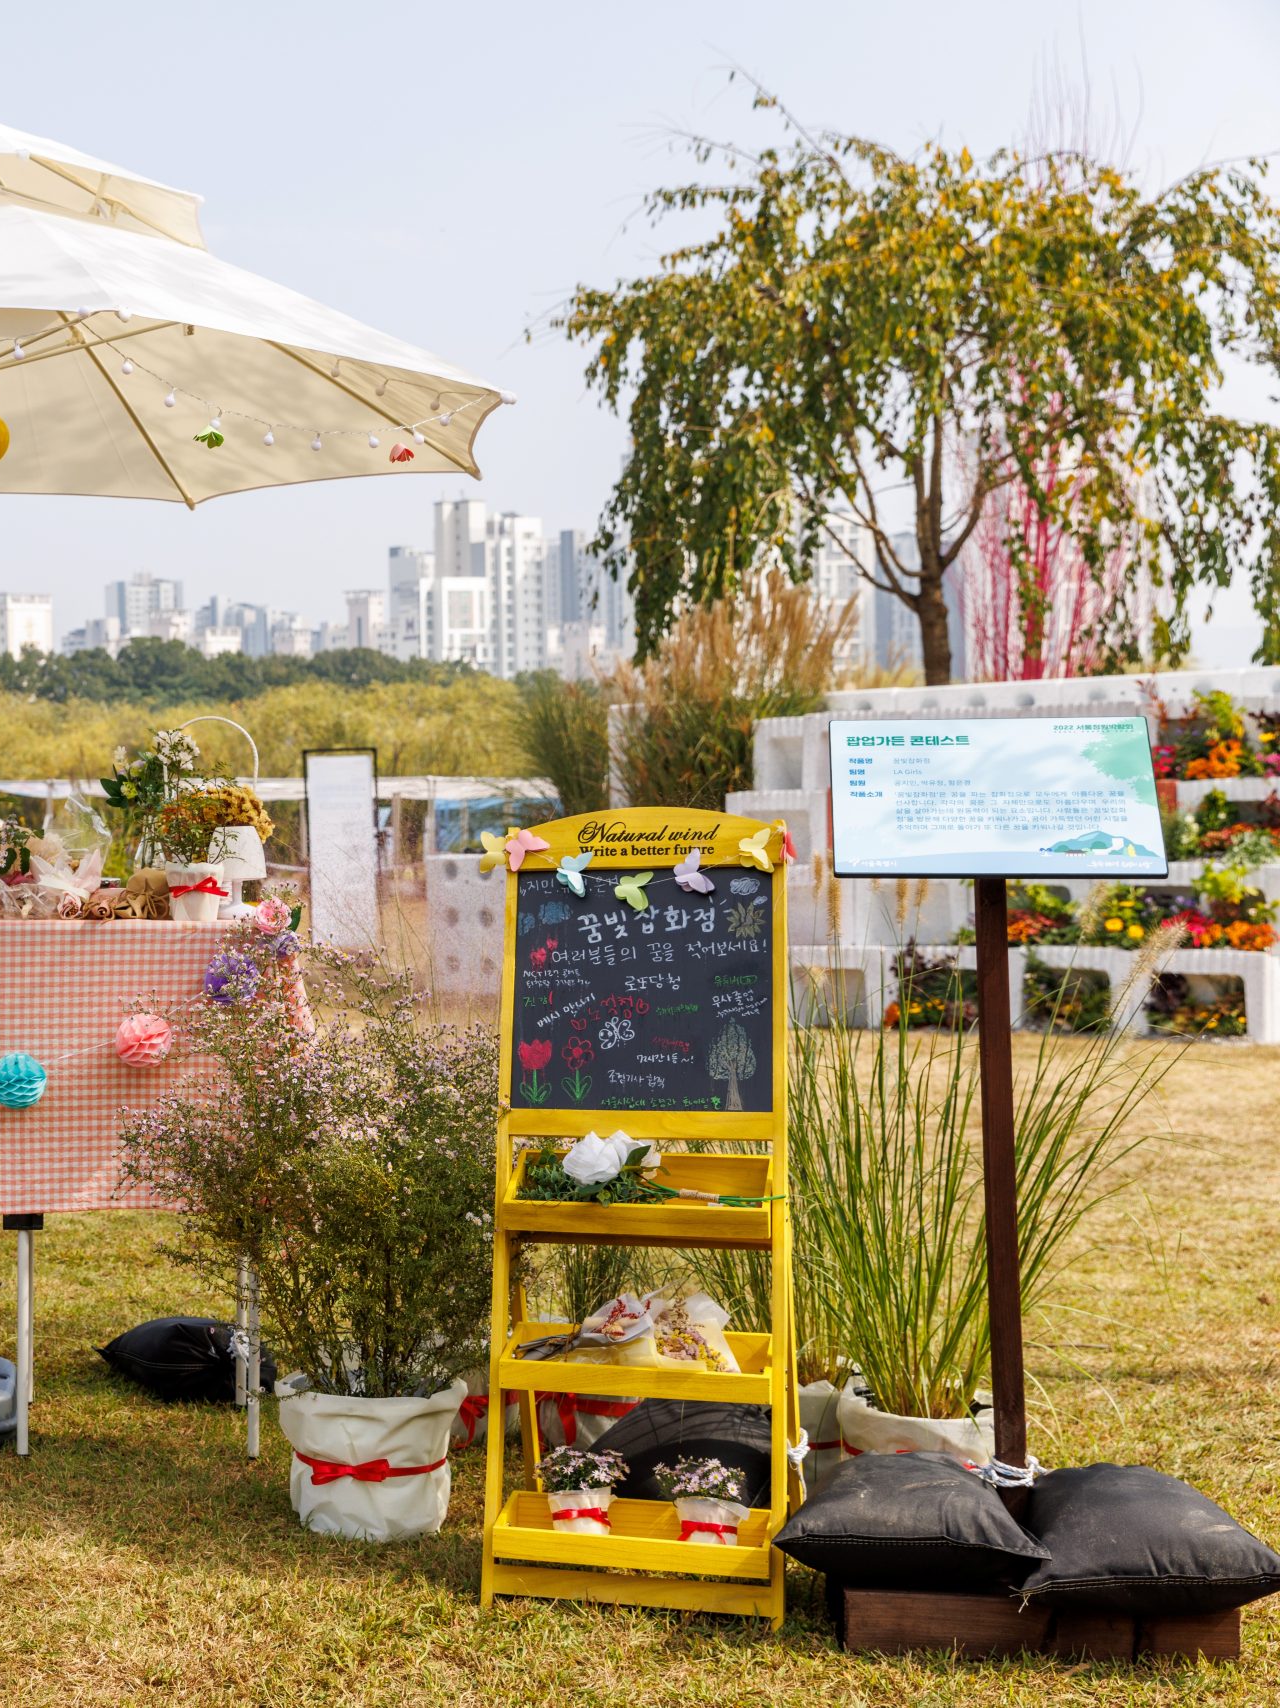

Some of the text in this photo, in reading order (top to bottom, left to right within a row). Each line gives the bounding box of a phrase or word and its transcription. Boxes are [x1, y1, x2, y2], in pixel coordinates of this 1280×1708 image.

[846, 735, 970, 747] 팝업가든 콘테스트
[848, 757, 873, 765] 작품명
[577, 821, 721, 844] Natural wind
[579, 845, 617, 857] Write
[620, 847, 628, 856] a
[631, 845, 671, 856] better
[552, 939, 768, 965] 여러분들의 꿈을 적어보세요!
